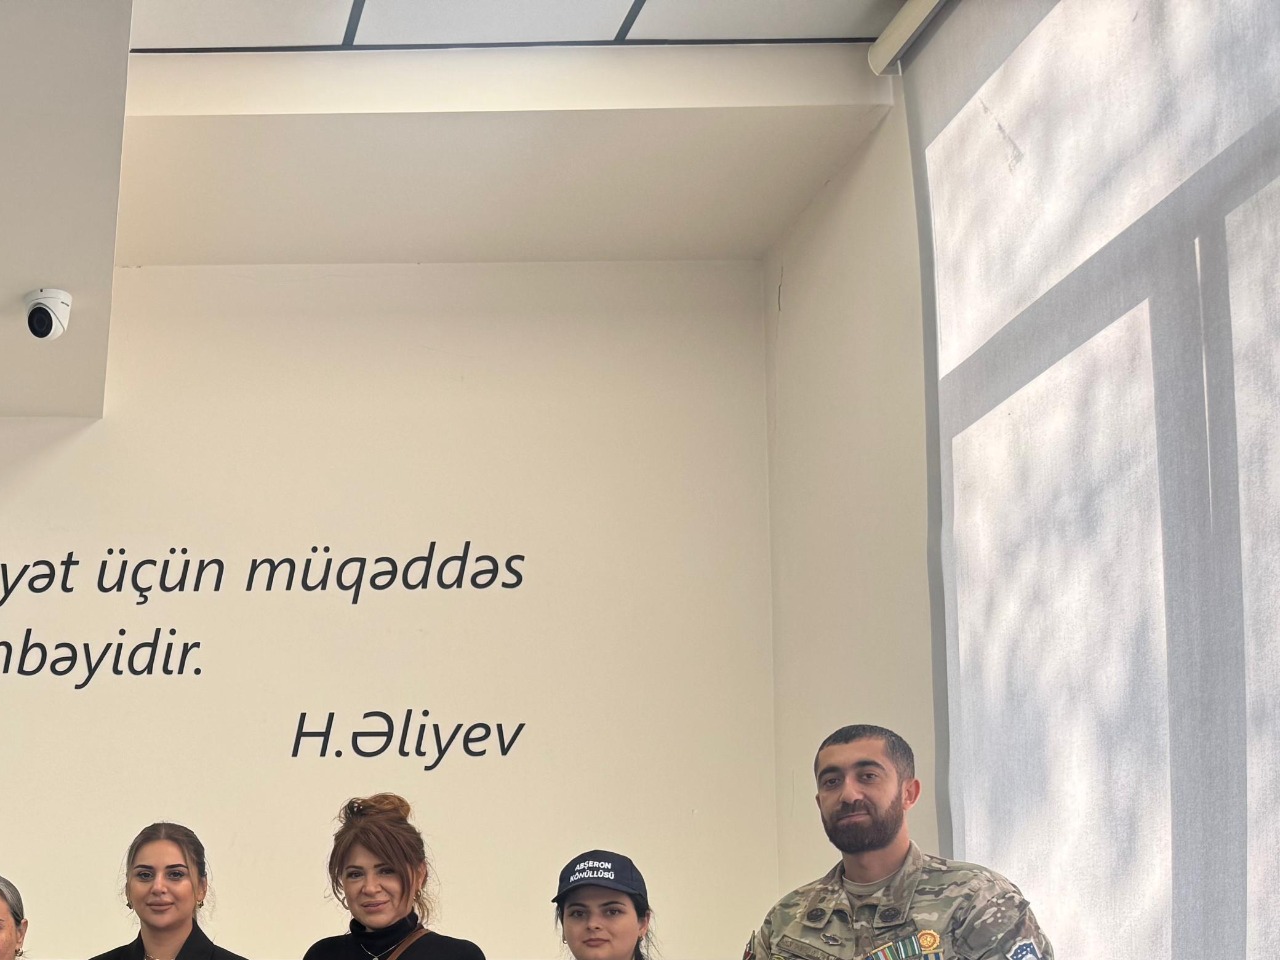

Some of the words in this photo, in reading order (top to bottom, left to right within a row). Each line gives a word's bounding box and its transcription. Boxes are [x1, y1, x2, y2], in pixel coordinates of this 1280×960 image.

[98, 548, 224, 605] üçün
[246, 541, 525, 604] müqəddəs
[292, 709, 525, 771] H.Əliyev
[569, 870, 615, 882] KÖNÜLLÜSÜ
[575, 860, 611, 871] ABŞERON
